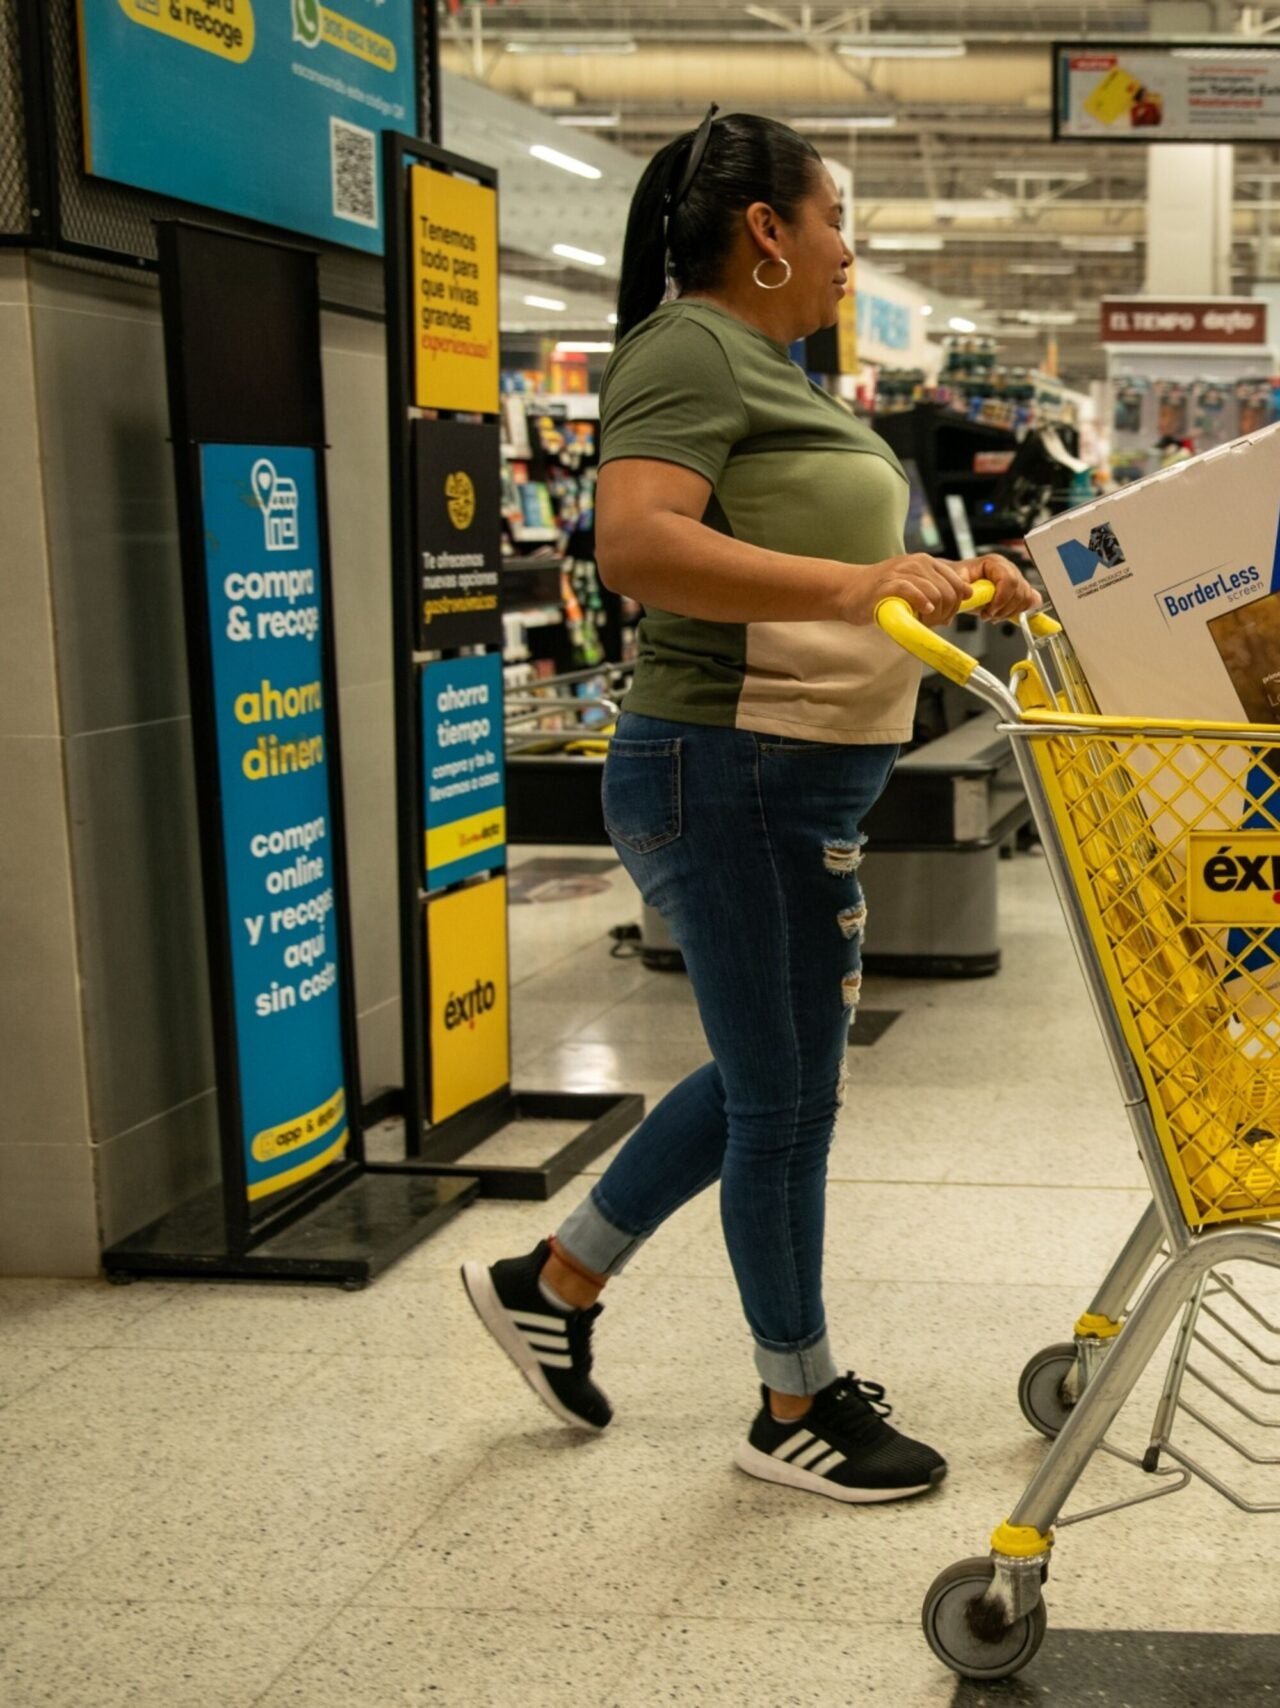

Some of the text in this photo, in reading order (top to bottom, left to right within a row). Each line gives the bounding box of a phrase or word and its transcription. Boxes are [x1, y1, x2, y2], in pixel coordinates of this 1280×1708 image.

[185, 6, 243, 49] recoge
[420, 215, 476, 251] Tenemos
[421, 247, 478, 283] todo para
[421, 279, 478, 306] que vivas
[422, 307, 471, 332] grandes
[1110, 311, 1128, 331] EL
[1132, 311, 1196, 332] TIEMPO
[422, 551, 484, 569] Te ofrecemos
[423, 570, 498, 591] nuevas opciones
[1164, 565, 1260, 617] BorderLess
[1227, 581, 1264, 603] screen
[226, 605, 252, 641] &
[1262, 671, 1280, 685] prime
[437, 684, 488, 712] ahorra
[437, 720, 490, 747] tiempo
[432, 759, 468, 779] compra
[468, 758, 474, 773] y
[430, 780, 471, 802] llevamos
[244, 915, 265, 946] y
[255, 981, 296, 1017] sin
[444, 979, 495, 1031] éxito
[276, 1127, 302, 1146] app
